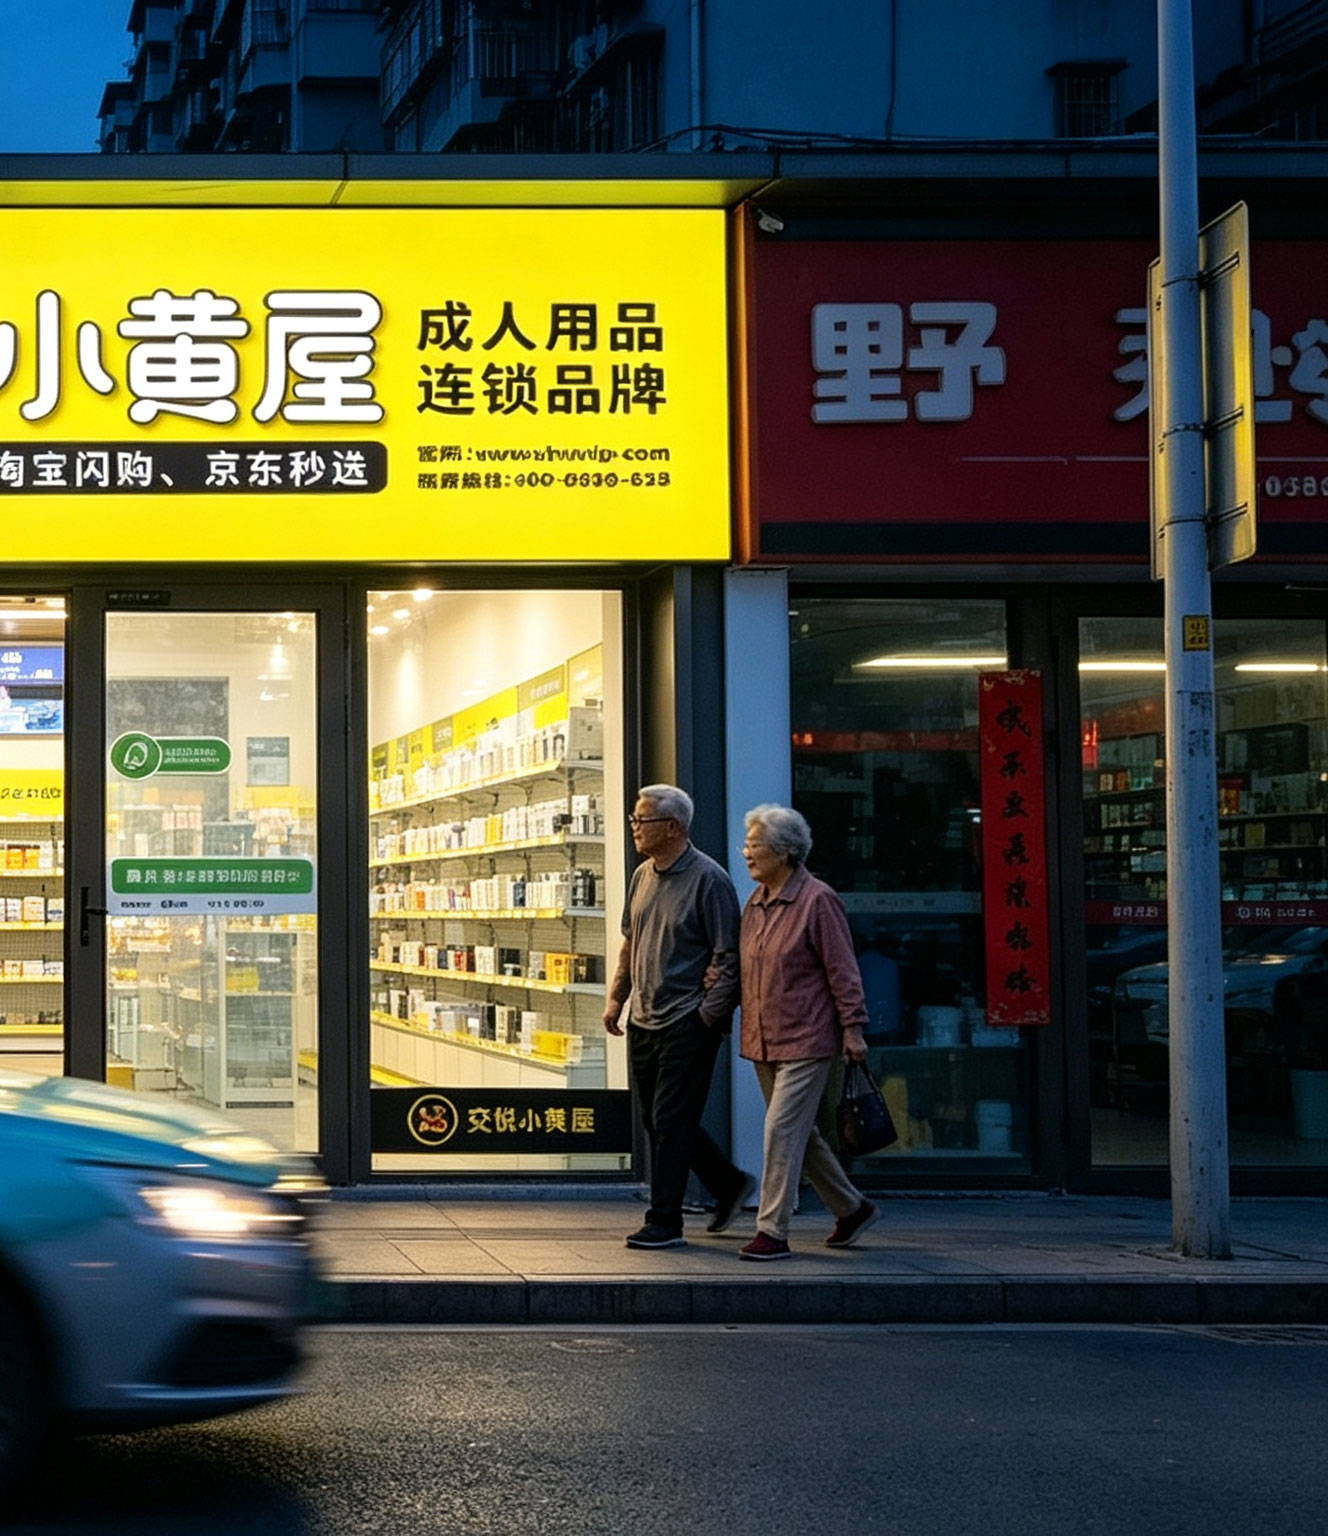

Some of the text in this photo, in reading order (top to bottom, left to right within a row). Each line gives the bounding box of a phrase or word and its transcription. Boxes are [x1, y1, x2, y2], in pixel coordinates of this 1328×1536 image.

[417, 300, 663, 352] 成人用品
[417, 362, 667, 416] 连锁品牌
